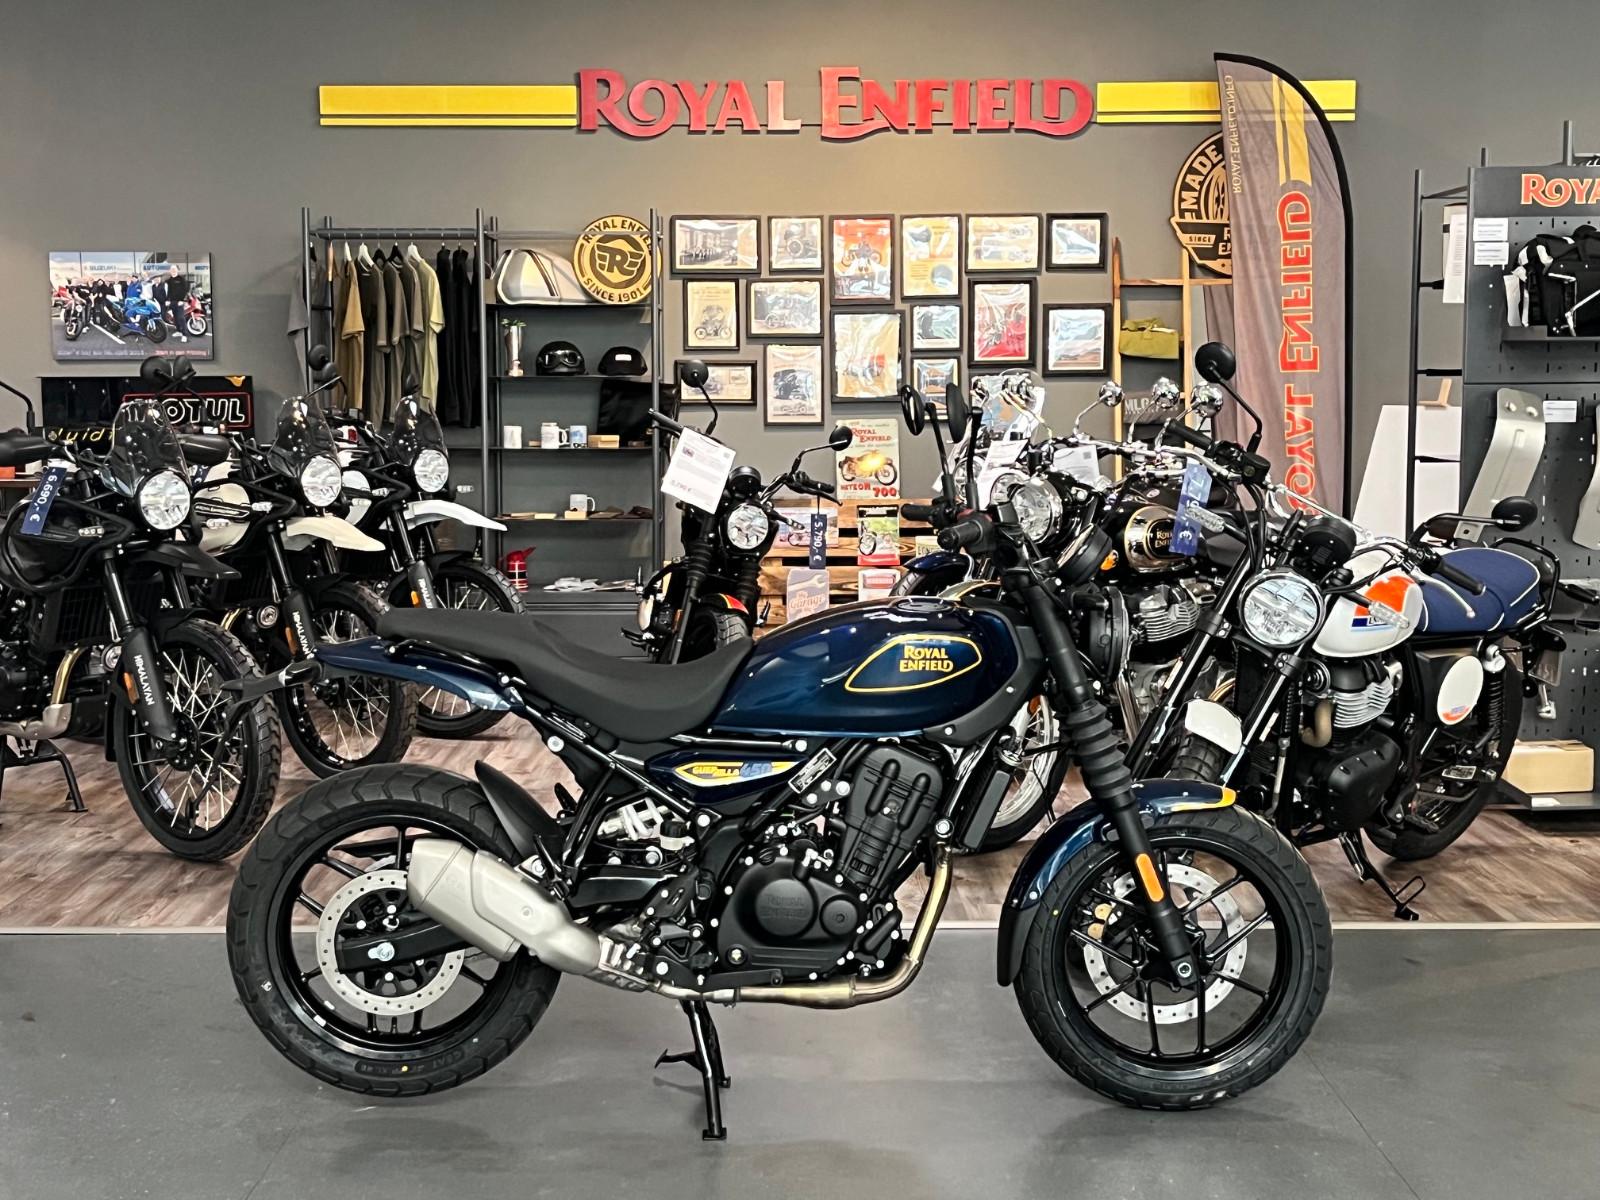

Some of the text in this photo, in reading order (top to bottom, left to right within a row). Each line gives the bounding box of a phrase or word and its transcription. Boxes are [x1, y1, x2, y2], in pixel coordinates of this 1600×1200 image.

[579, 66, 1093, 139] ROYAL ENFIELD
[1181, 144, 1222, 209] MADE
[582, 219, 618, 244] ROYAL
[584, 278, 644, 302] SINCE 1901
[873, 487, 897, 498] 700
[903, 645, 949, 660] ROYAL
[899, 659, 954, 673] ENFIELD
[133, 654, 156, 706] HIMALAYAN
